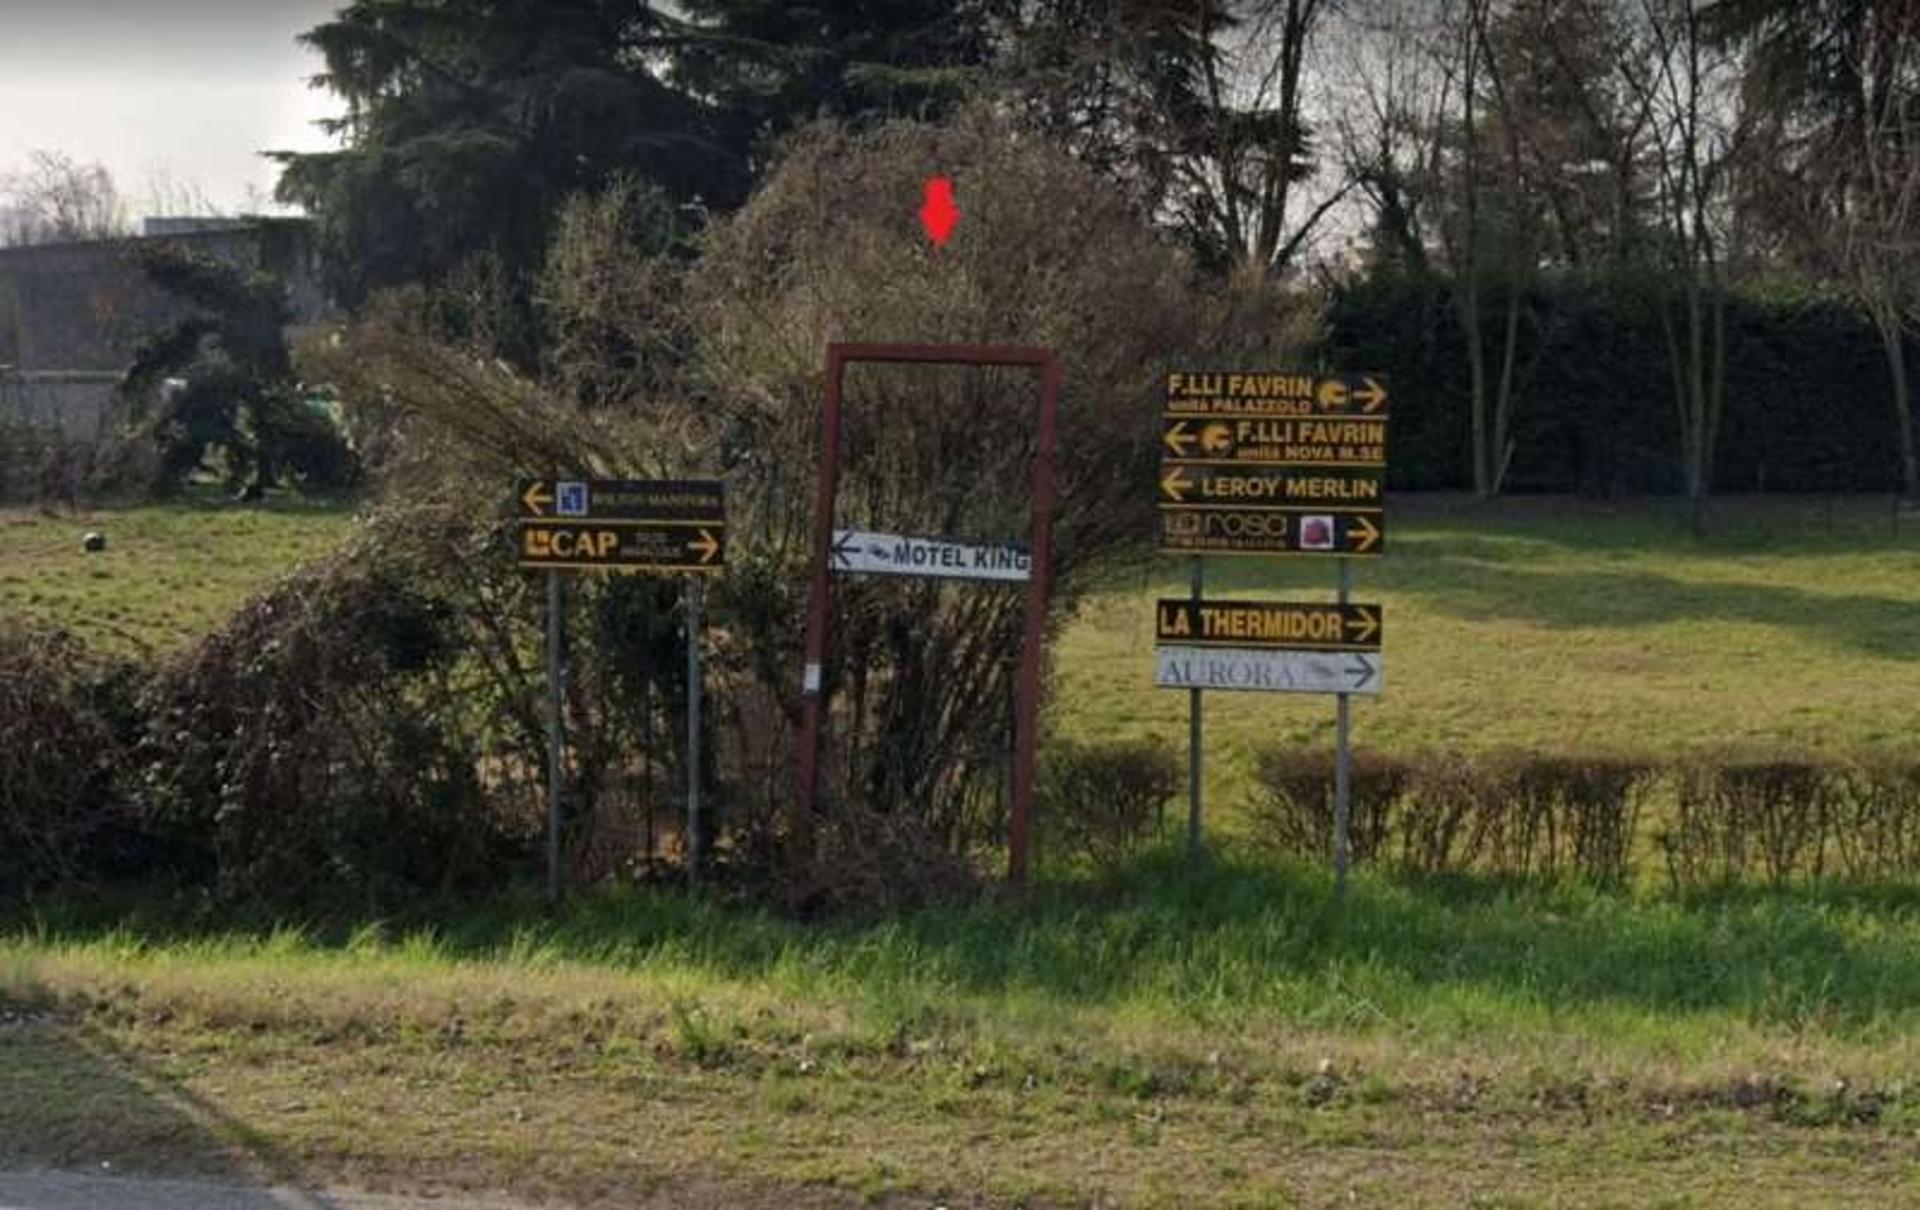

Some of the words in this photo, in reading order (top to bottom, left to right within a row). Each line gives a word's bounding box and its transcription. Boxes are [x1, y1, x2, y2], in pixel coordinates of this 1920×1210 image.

[1168, 374, 1222, 397] F.LLI
[1228, 376, 1312, 397] FAVRIN
[1237, 421, 1292, 442] F.LLI
[1300, 422, 1384, 443] FAVRIN
[1285, 445, 1334, 460] NOVA
[1203, 476, 1281, 497] LEROY
[1286, 478, 1378, 498] MERLIN
[1206, 512, 1287, 536] rosa
[551, 530, 618, 557] CAP
[892, 543, 966, 568] MOTEL
[973, 547, 1033, 571] KING
[1160, 606, 1190, 635] LA
[1201, 609, 1344, 640] THERMIDOR
[1162, 660, 1297, 686] AURORA
